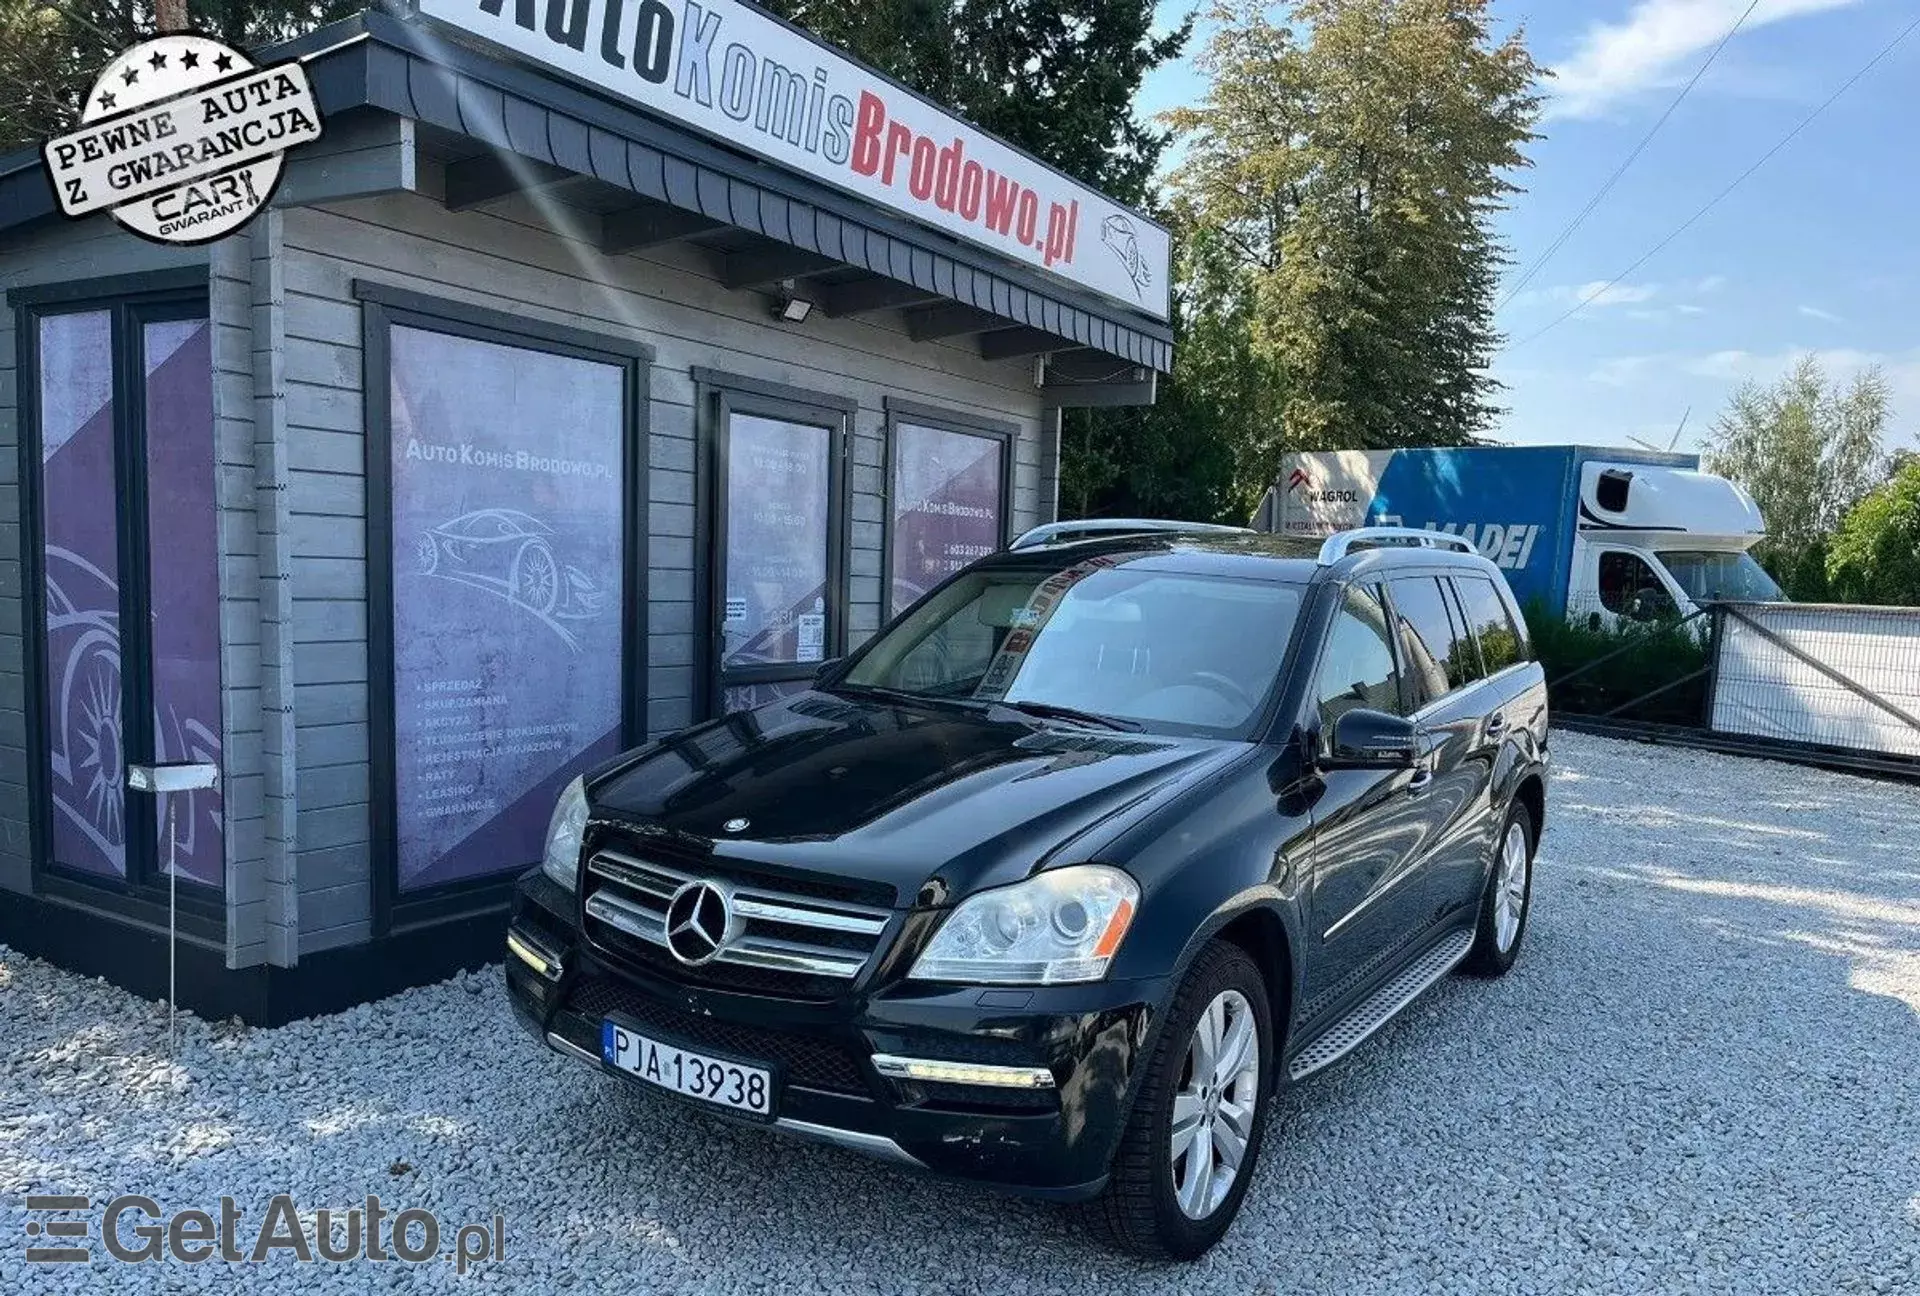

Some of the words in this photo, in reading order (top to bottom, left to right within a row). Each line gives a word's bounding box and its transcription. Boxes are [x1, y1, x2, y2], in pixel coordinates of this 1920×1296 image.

[478, 0, 1079, 267] utoKomisBrodowo.pl
[616, 1030, 661, 1081] PJA
[673, 1053, 766, 1110] 13938
